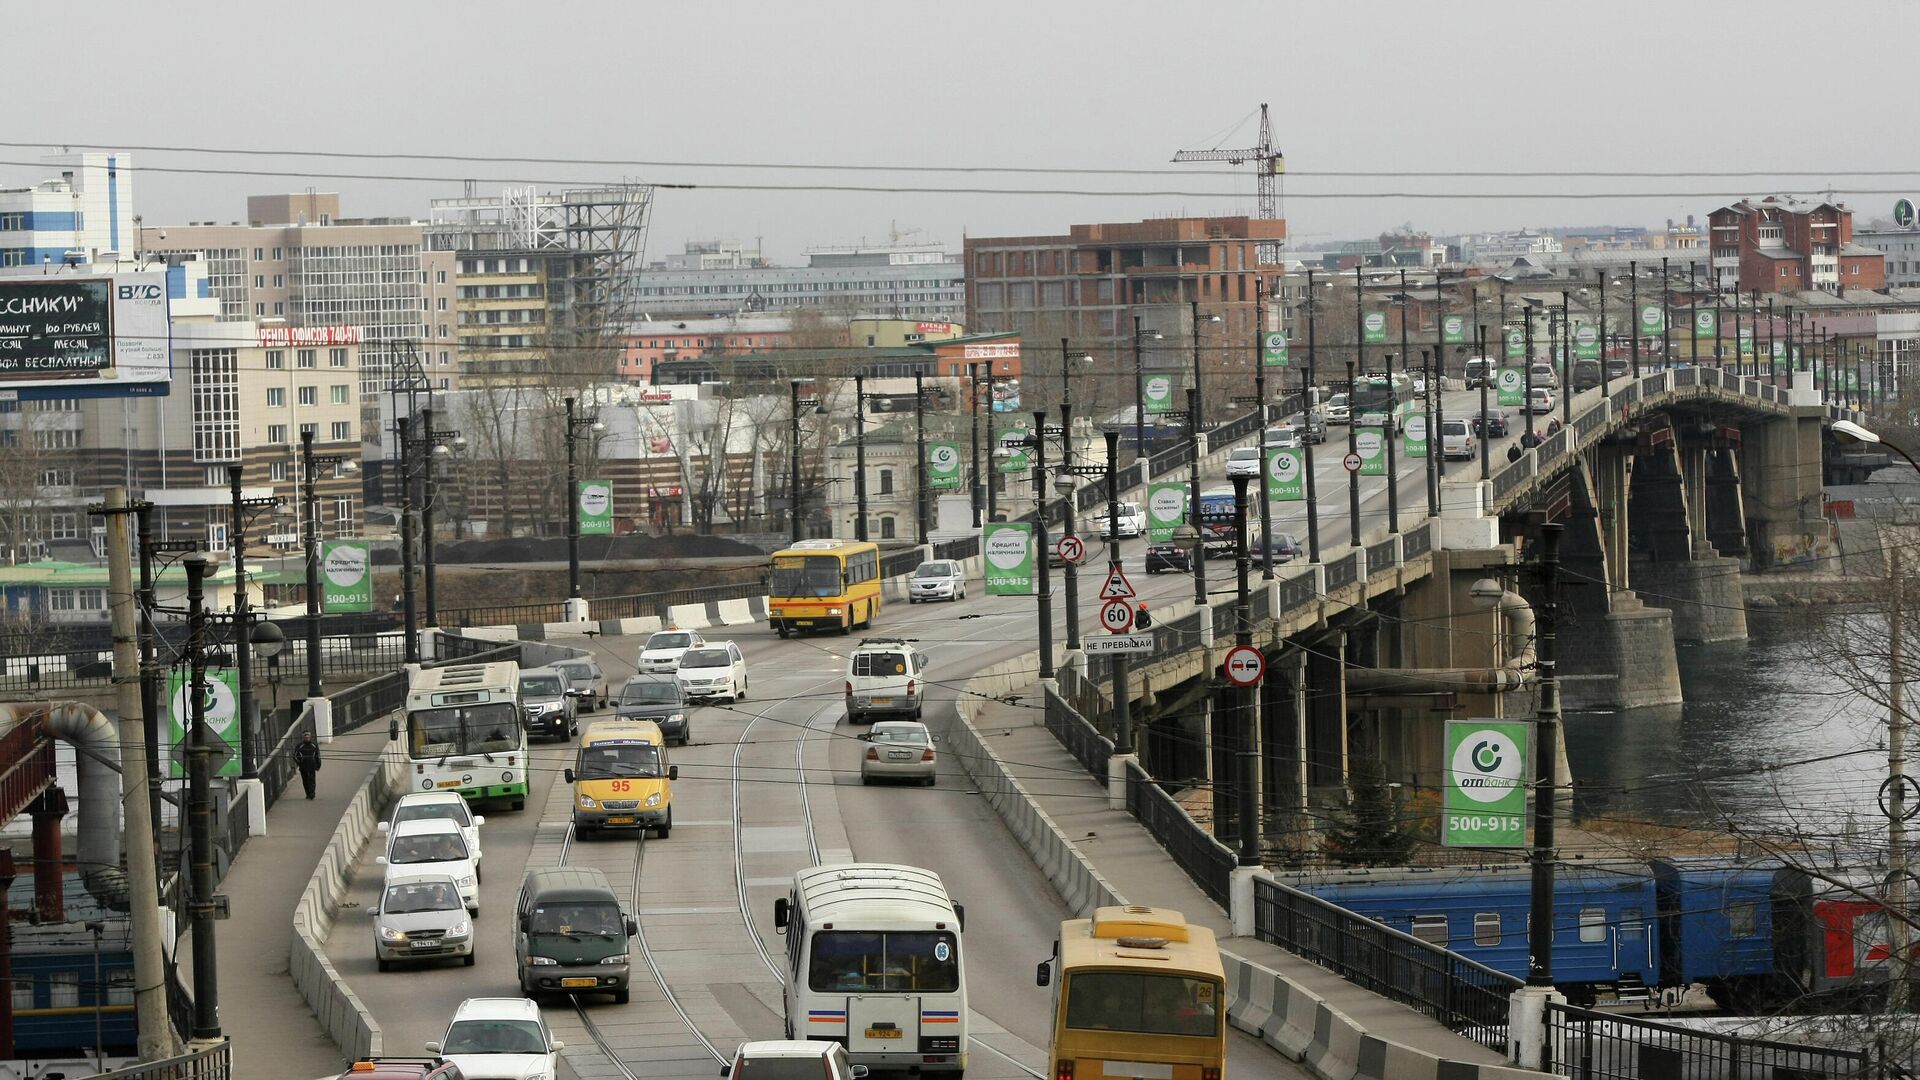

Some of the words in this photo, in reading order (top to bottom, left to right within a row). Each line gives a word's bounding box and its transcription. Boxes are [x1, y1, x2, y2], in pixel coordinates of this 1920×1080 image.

[118, 285, 161, 300] BWC
[63, 322, 100, 333] РУБЛЕЙ
[255, 328, 290, 347] АРЕНДА
[291, 327, 328, 346] ОФИСОВ
[54, 339, 89, 350] МЕСЯЦ
[25, 356, 101, 368] БЕСПЛАТНЫ!
[1269, 487, 1300, 495] 500-915
[1151, 528, 1175, 536] 500-9
[987, 577, 1029, 586] 500-915
[326, 593, 368, 604] 500-915
[1107, 609, 1126, 622] 60
[1102, 639, 1152, 649] ПРЕВЫШАЙ
[611, 780, 630, 792] 95
[1449, 816, 1520, 831] 500-915
[1199, 986, 1212, 997] 26
